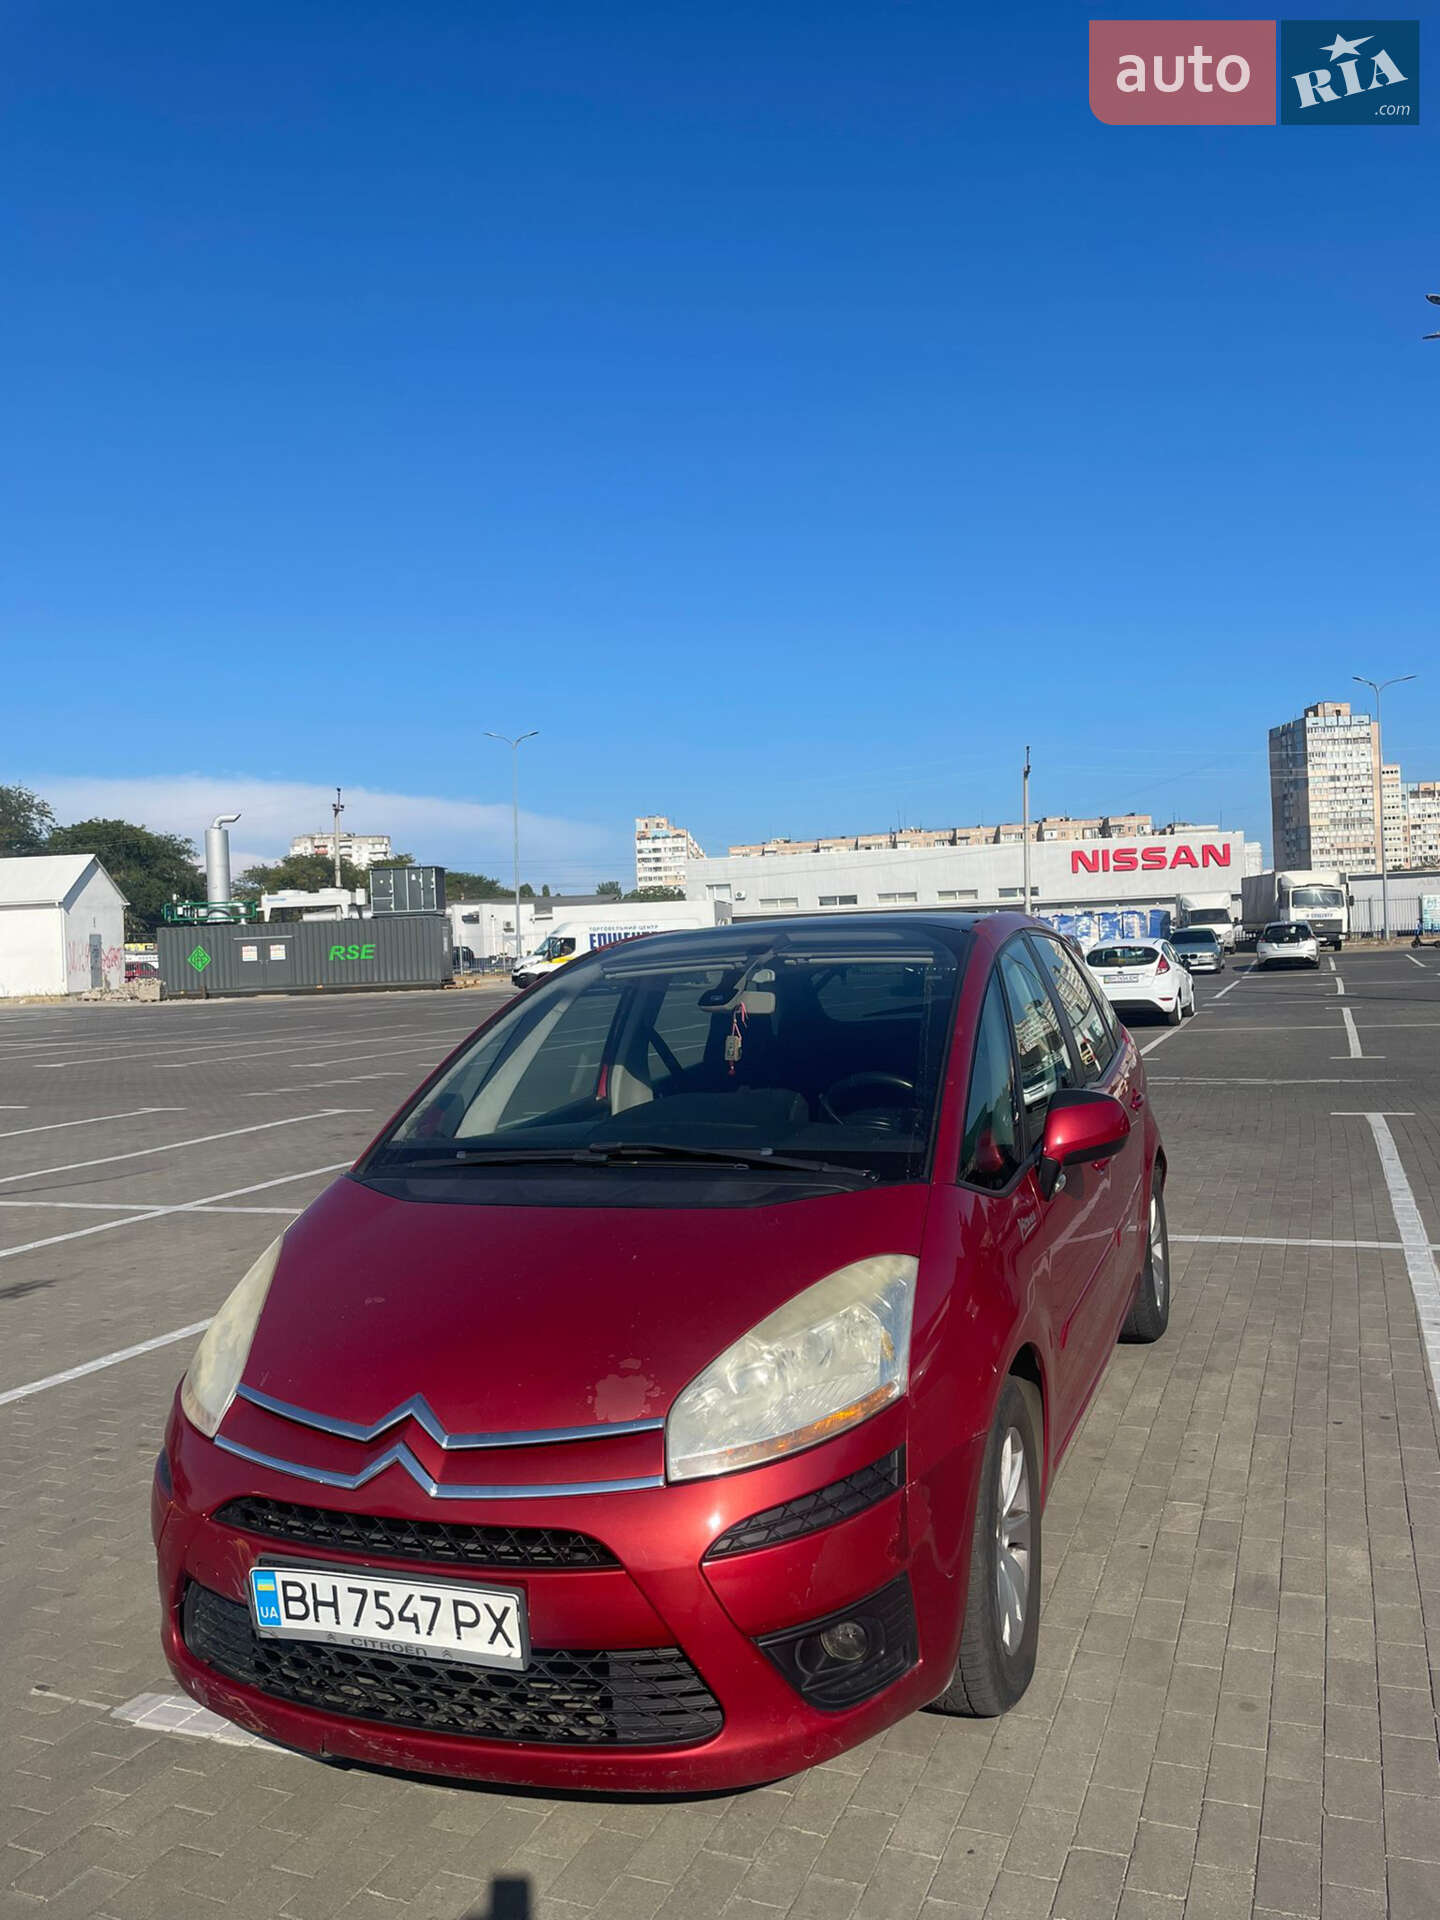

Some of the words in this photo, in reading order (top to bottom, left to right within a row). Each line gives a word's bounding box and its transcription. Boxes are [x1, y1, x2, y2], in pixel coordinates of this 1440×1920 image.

[1071, 843, 1231, 874] NISSAN
[329, 944, 376, 960] RSE
[260, 1605, 279, 1619] UA
